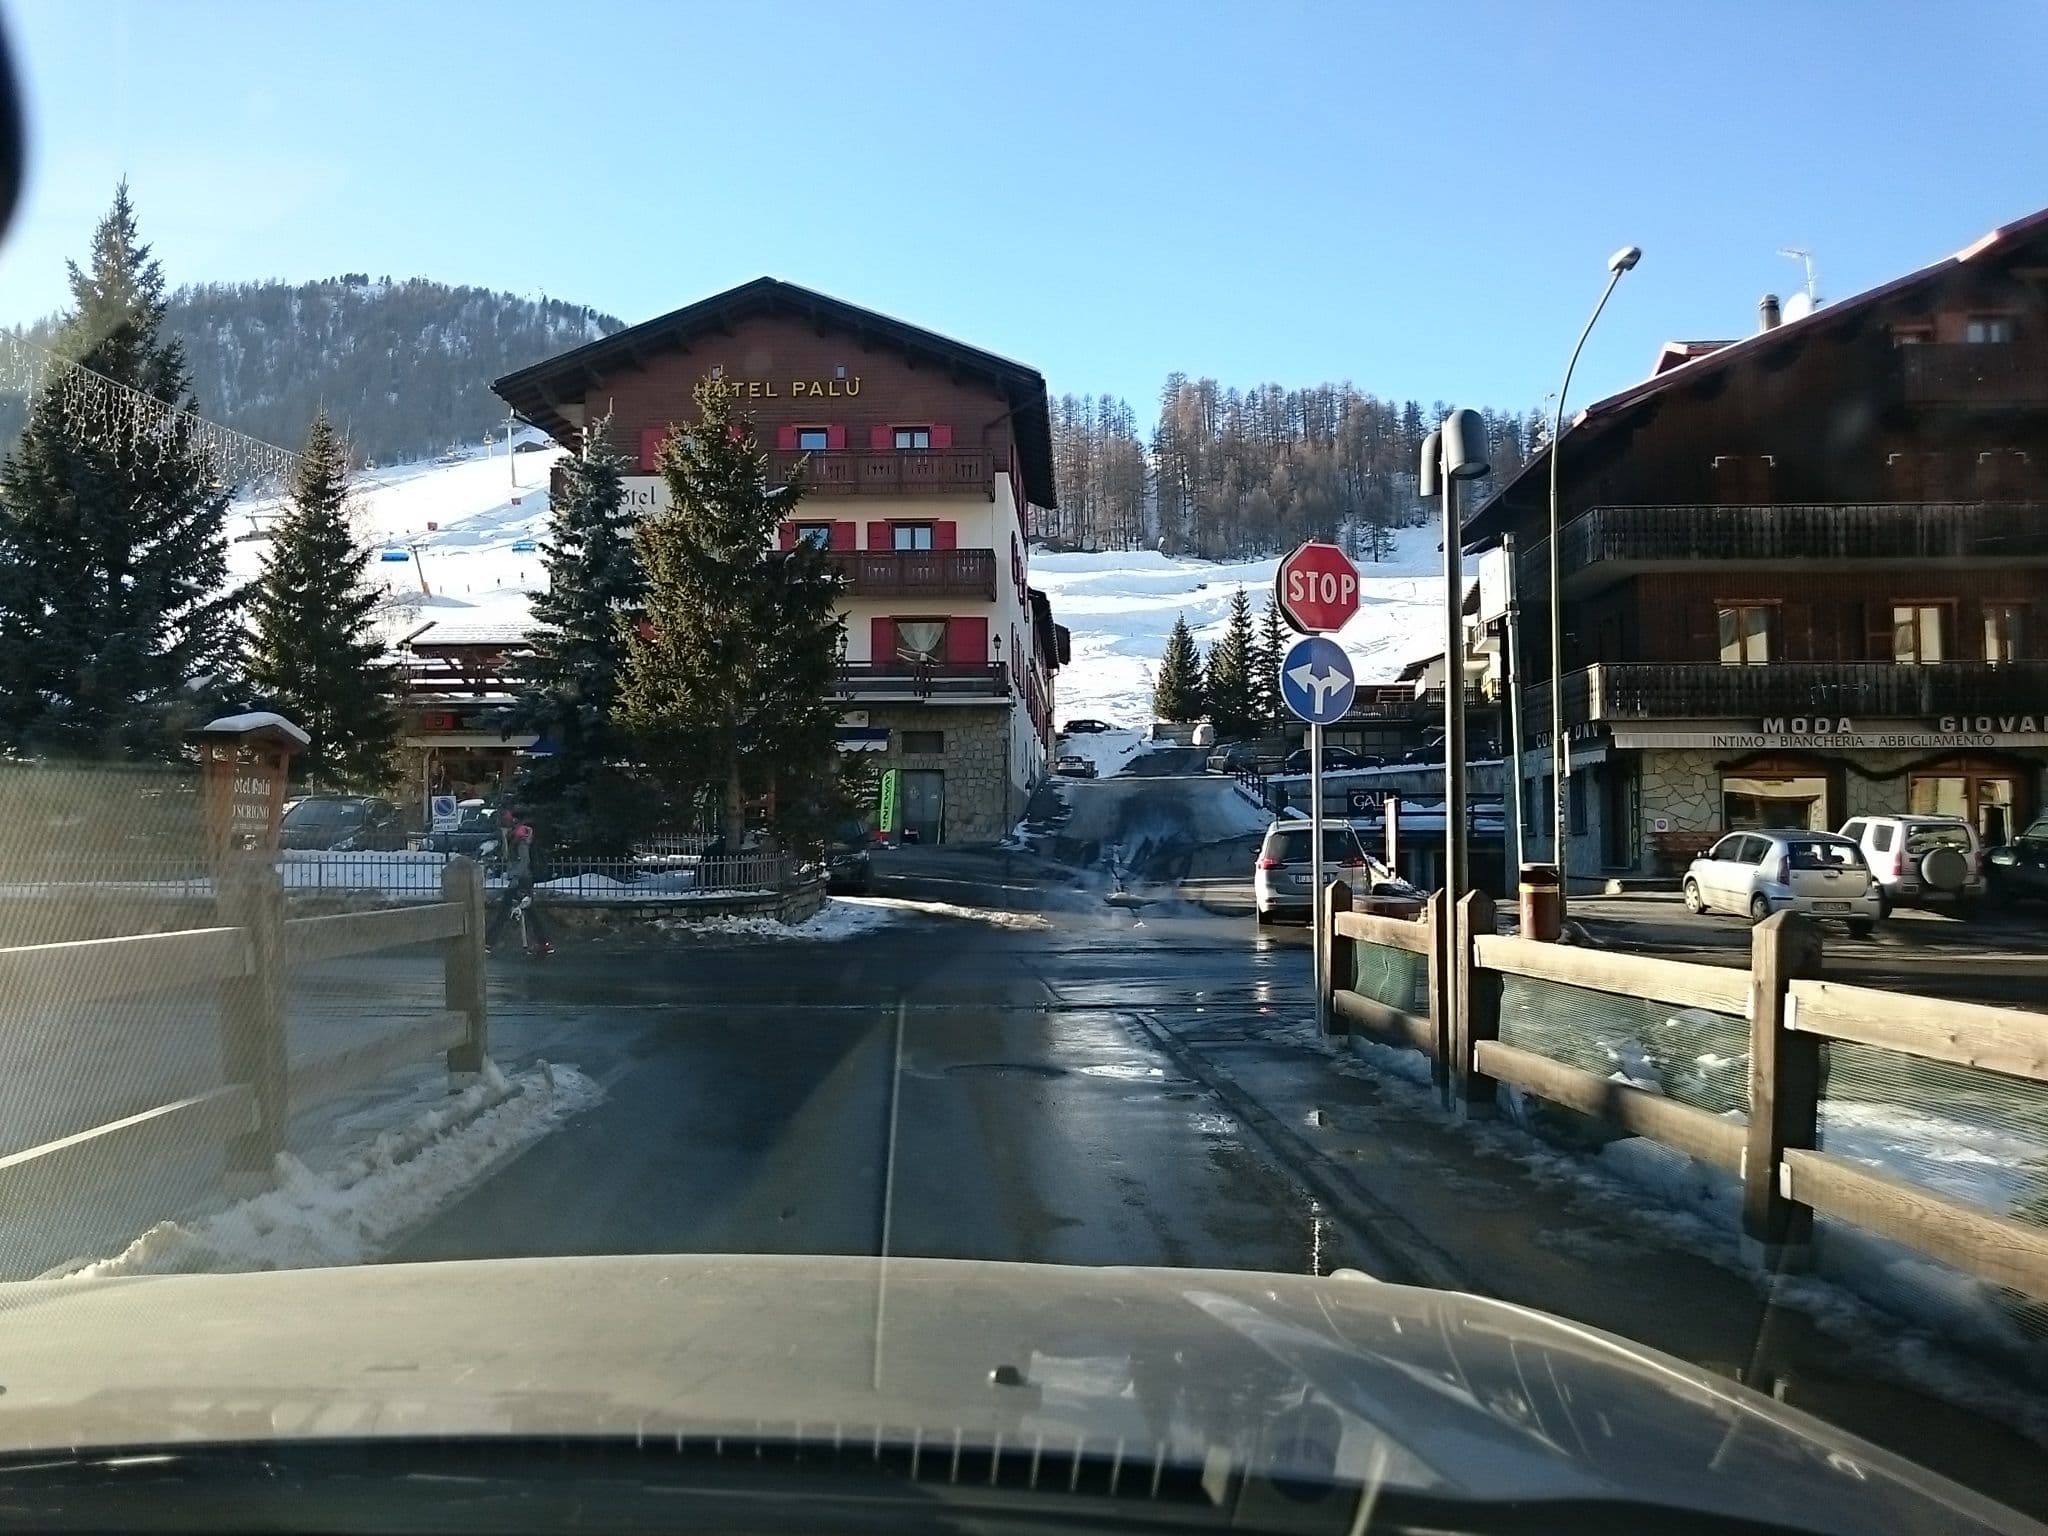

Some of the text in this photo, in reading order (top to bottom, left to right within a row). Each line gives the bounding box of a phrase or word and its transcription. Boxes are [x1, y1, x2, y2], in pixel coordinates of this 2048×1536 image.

[791, 377, 861, 397] PALÙ
[1289, 570, 1356, 605] STOP
[1762, 716, 1852, 734] MODA
[1712, 736, 1766, 747] INTIMO
[1780, 736, 1864, 747] BIANCHERIA
[1878, 735, 1995, 747] ABBIGLIAMENTO
